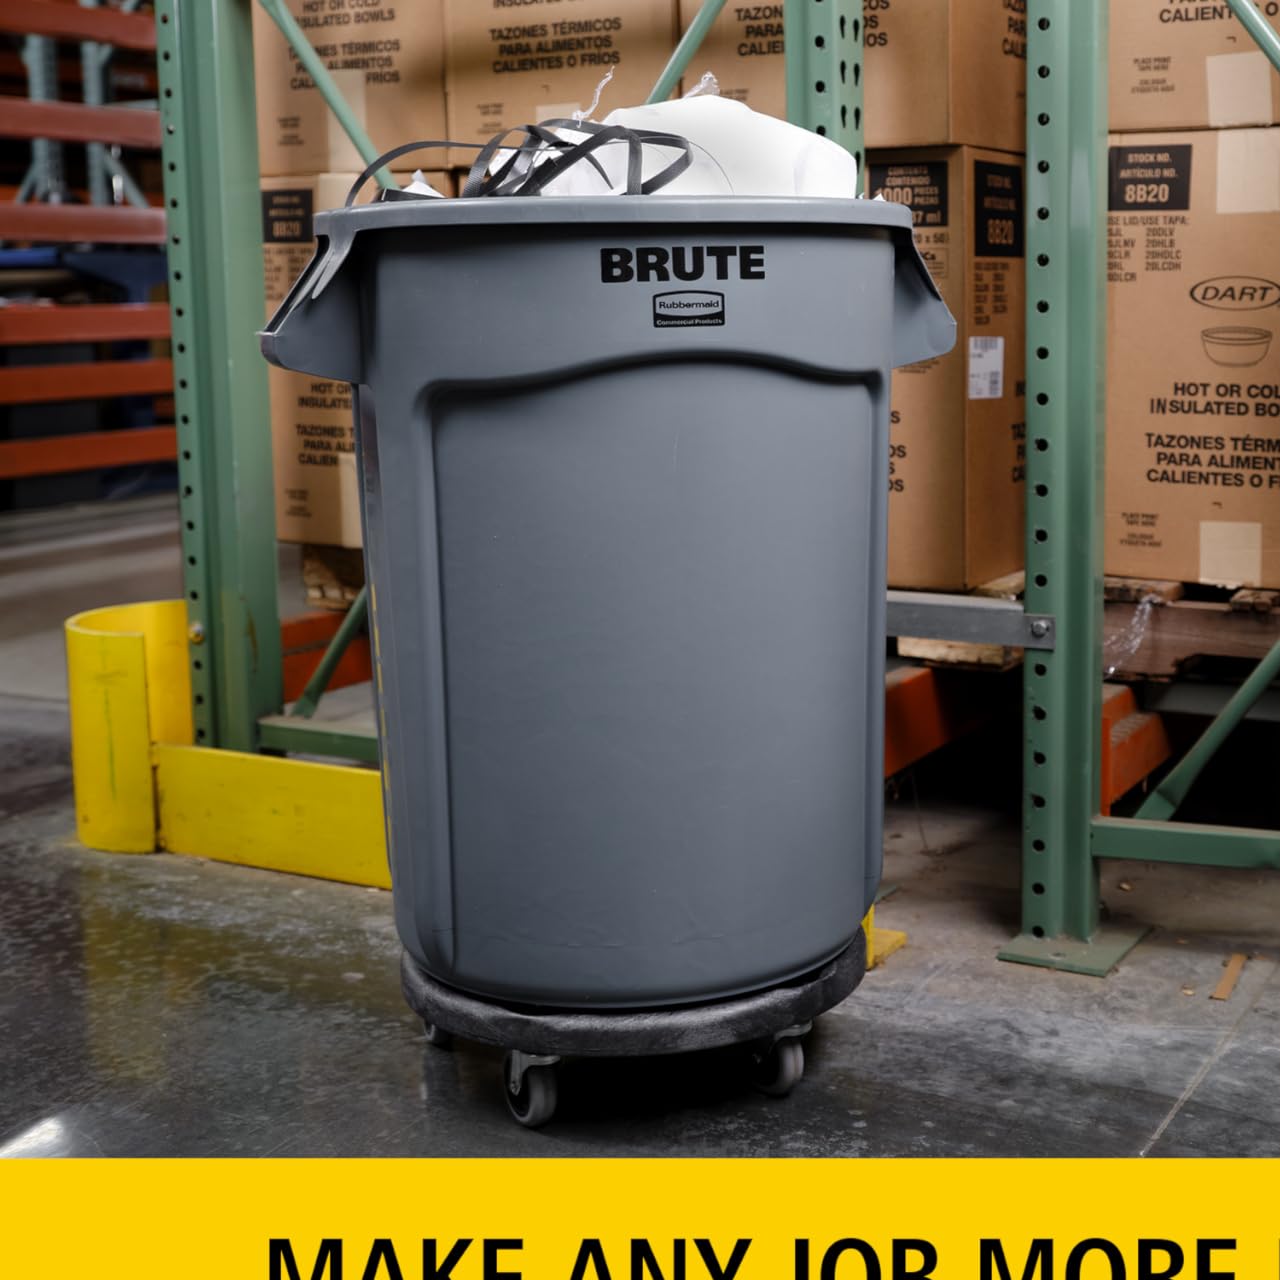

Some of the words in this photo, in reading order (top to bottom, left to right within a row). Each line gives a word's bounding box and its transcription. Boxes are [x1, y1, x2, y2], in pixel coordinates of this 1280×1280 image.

[353, 8, 396, 23] BOWLS
[735, 5, 783, 22] TAZON
[1159, 5, 1233, 23] CALIENT
[1264, 1, 1279, 17] O
[489, 24, 548, 41] TAZONES
[551, 17, 622, 36] TÉRMICOS
[498, 42, 533, 57] PARA
[536, 35, 613, 55] ALIMENTOS
[737, 41, 784, 57] CALIE
[492, 56, 563, 74] CALIENTES
[567, 55, 578, 69] O
[580, 51, 621, 67] FRÍOS
[1128, 153, 1155, 164] STOCK
[1124, 184, 1170, 204] 8B20
[600, 245, 766, 283] BRUTE
[1201, 286, 1273, 301] DART
[658, 300, 720, 310] Rubbermaid
[311, 383, 333, 395] HOT
[1173, 382, 1210, 397] HOT
[1215, 383, 1242, 398] OR
[1150, 398, 1250, 416] INSULATED
[295, 424, 345, 438] TAZONES
[303, 440, 332, 451] PARA
[1145, 432, 1226, 450] TAZONES
[1156, 452, 1203, 467] PARA
[1146, 469, 1245, 487] CALIENTES
[1249, 474, 1264, 488] O
